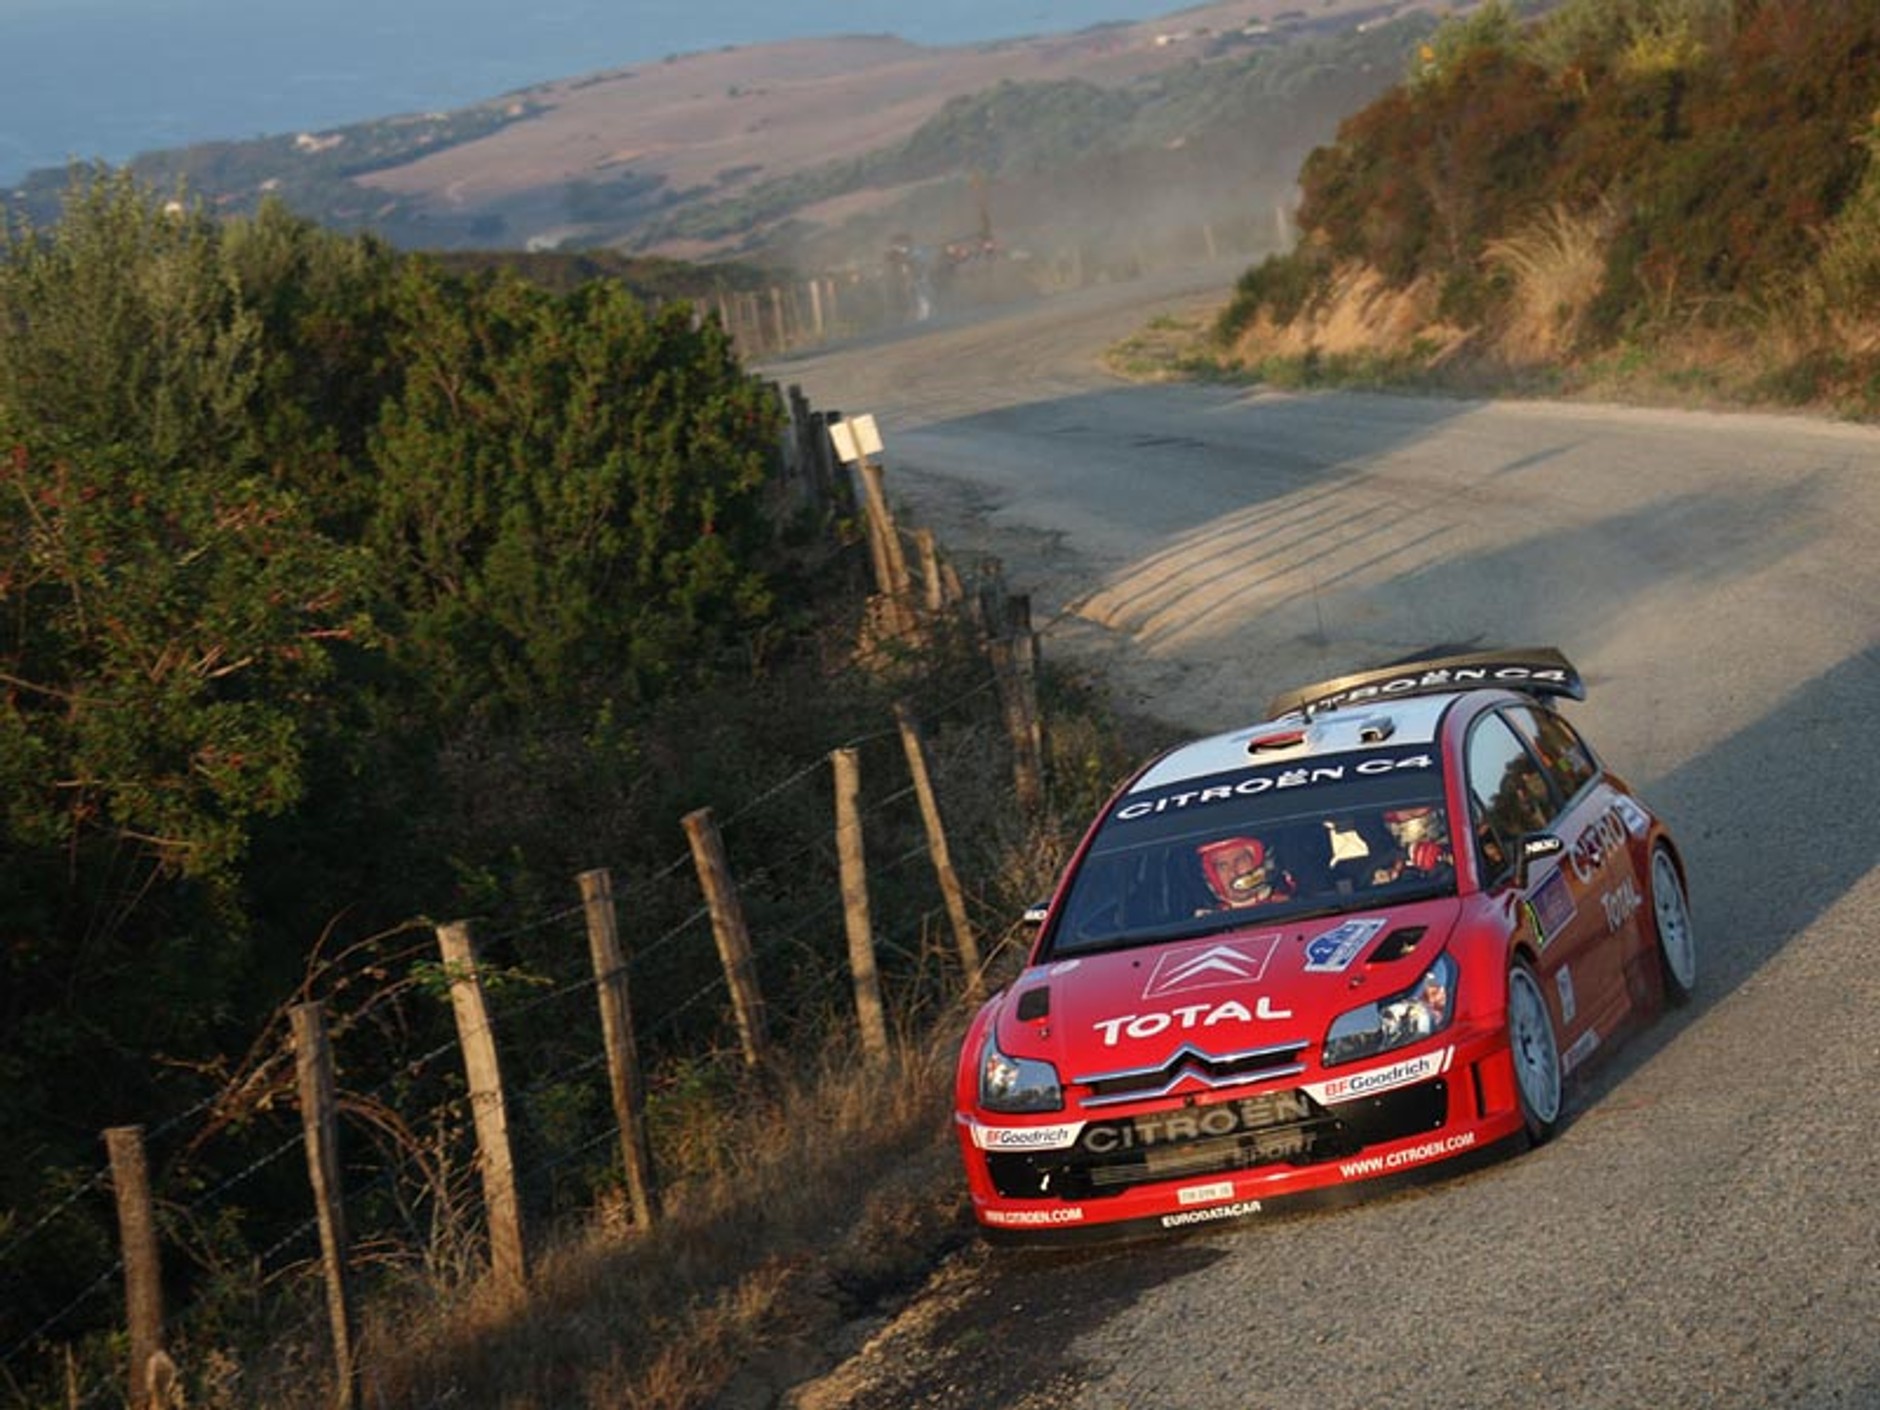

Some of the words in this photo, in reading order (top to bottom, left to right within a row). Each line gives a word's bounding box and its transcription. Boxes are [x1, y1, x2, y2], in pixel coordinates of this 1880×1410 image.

[1494, 668, 1568, 682] C4
[1356, 754, 1433, 774] C4
[1093, 997, 1293, 1046] TOTAL
[1325, 1059, 1431, 1096] BFGoodrich
[1162, 1200, 1262, 1228] EURODATACAR
